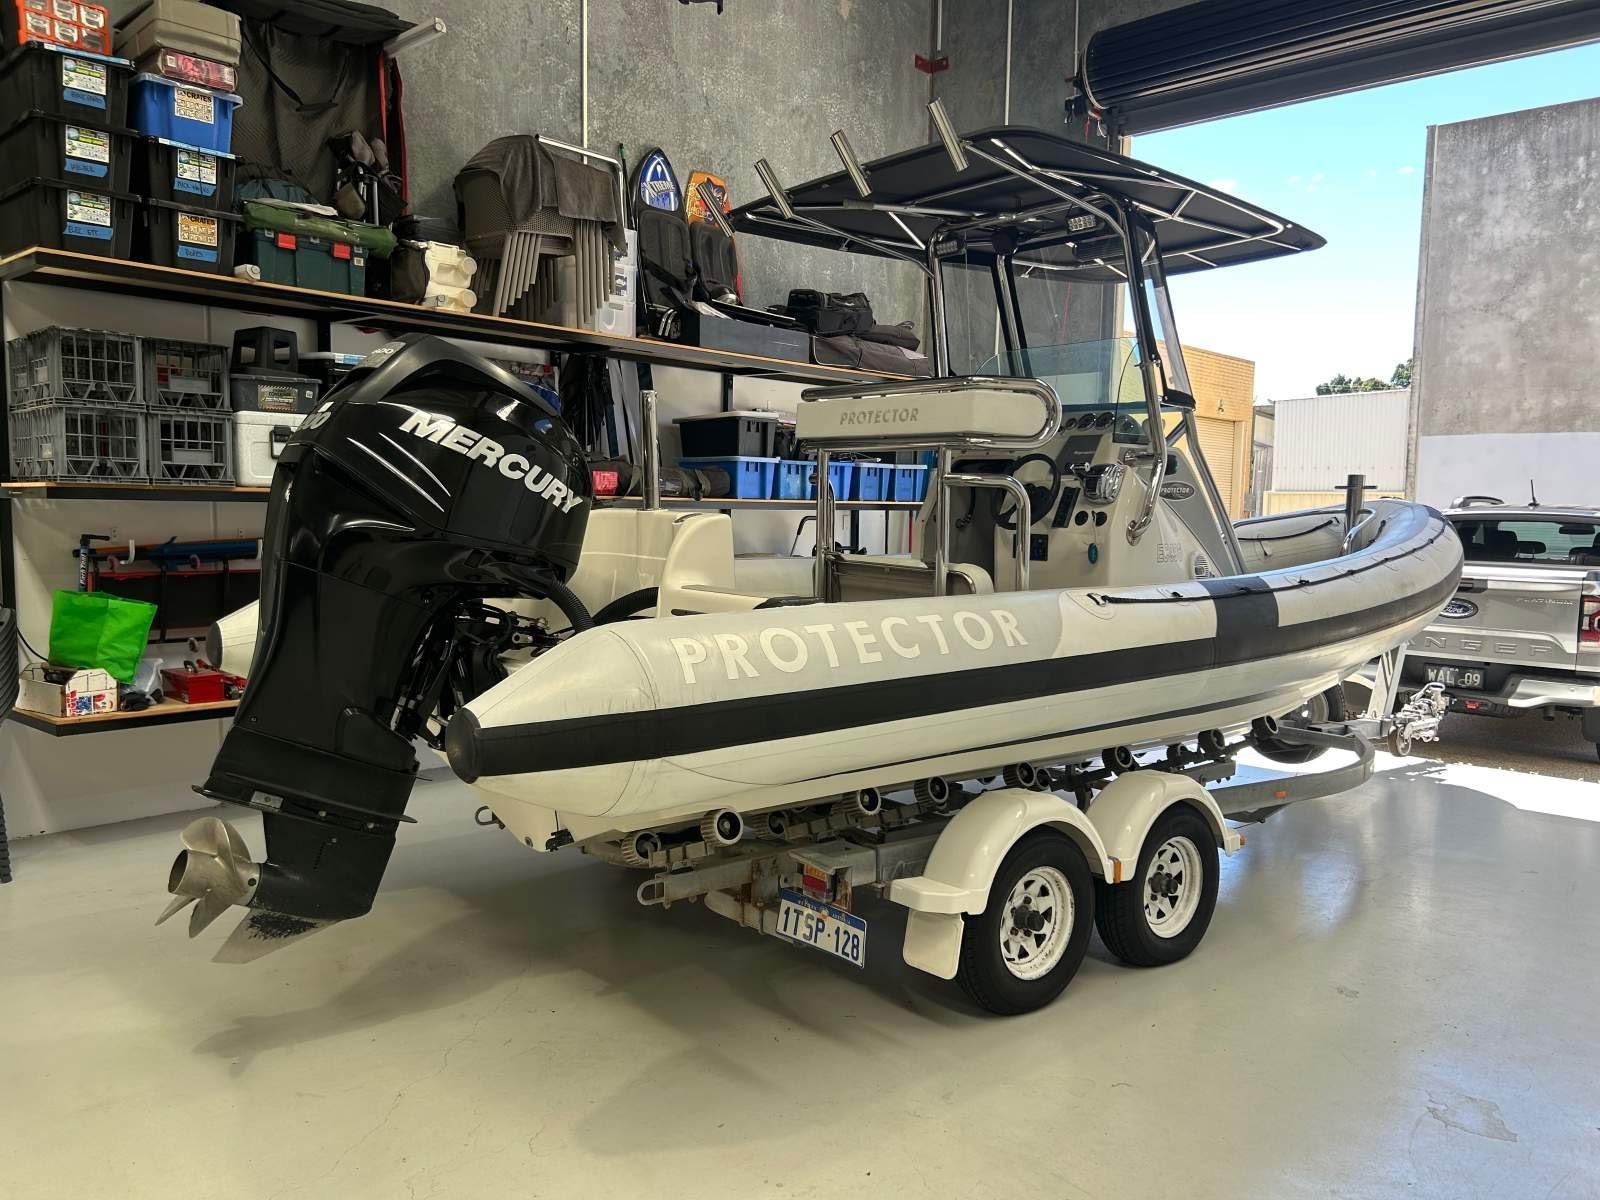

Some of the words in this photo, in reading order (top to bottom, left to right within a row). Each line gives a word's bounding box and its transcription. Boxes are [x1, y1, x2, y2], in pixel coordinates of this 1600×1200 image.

[839, 407, 919, 425] PROTECTOR
[398, 410, 583, 514] MERCURY
[671, 609, 1029, 684] PROTECTOR
